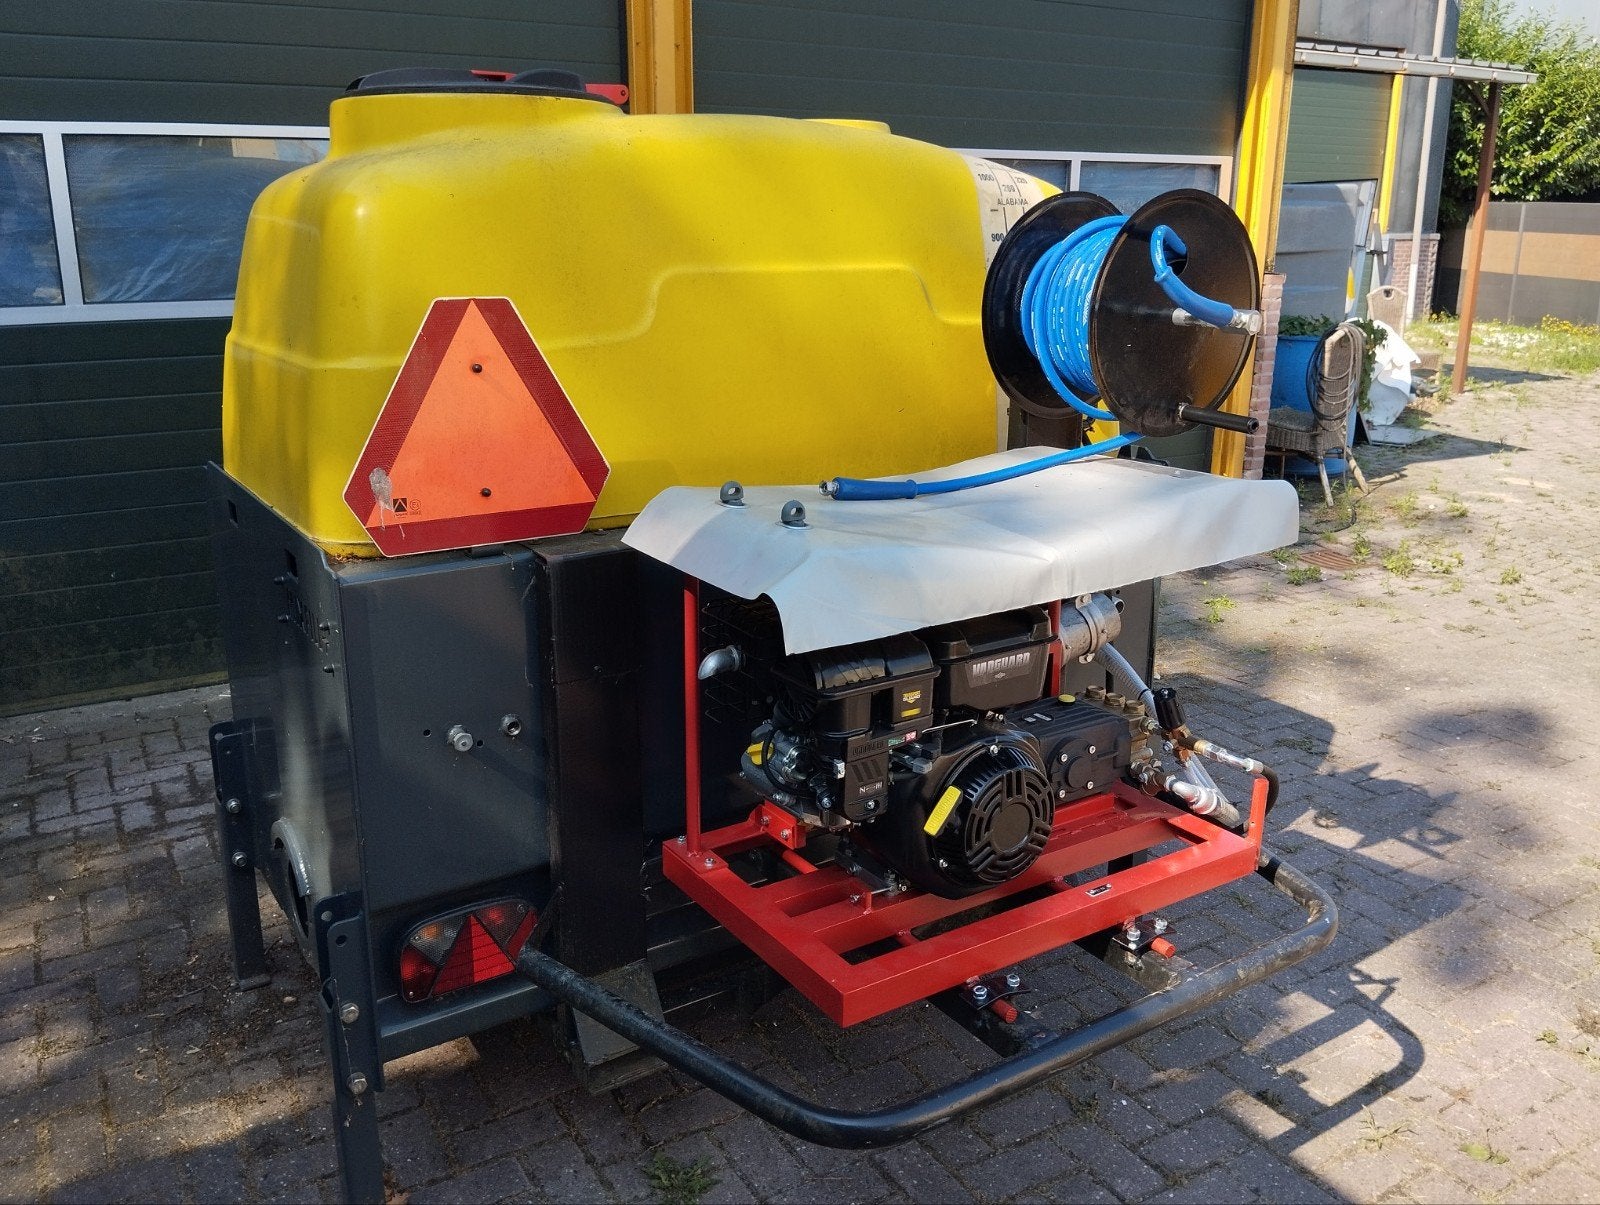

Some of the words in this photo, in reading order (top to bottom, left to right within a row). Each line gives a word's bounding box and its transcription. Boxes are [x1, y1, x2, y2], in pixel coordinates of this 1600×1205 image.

[997, 198, 1029, 206] ALABAMA
[991, 232, 1005, 242] 900
[972, 652, 1030, 676] VANGUARD
